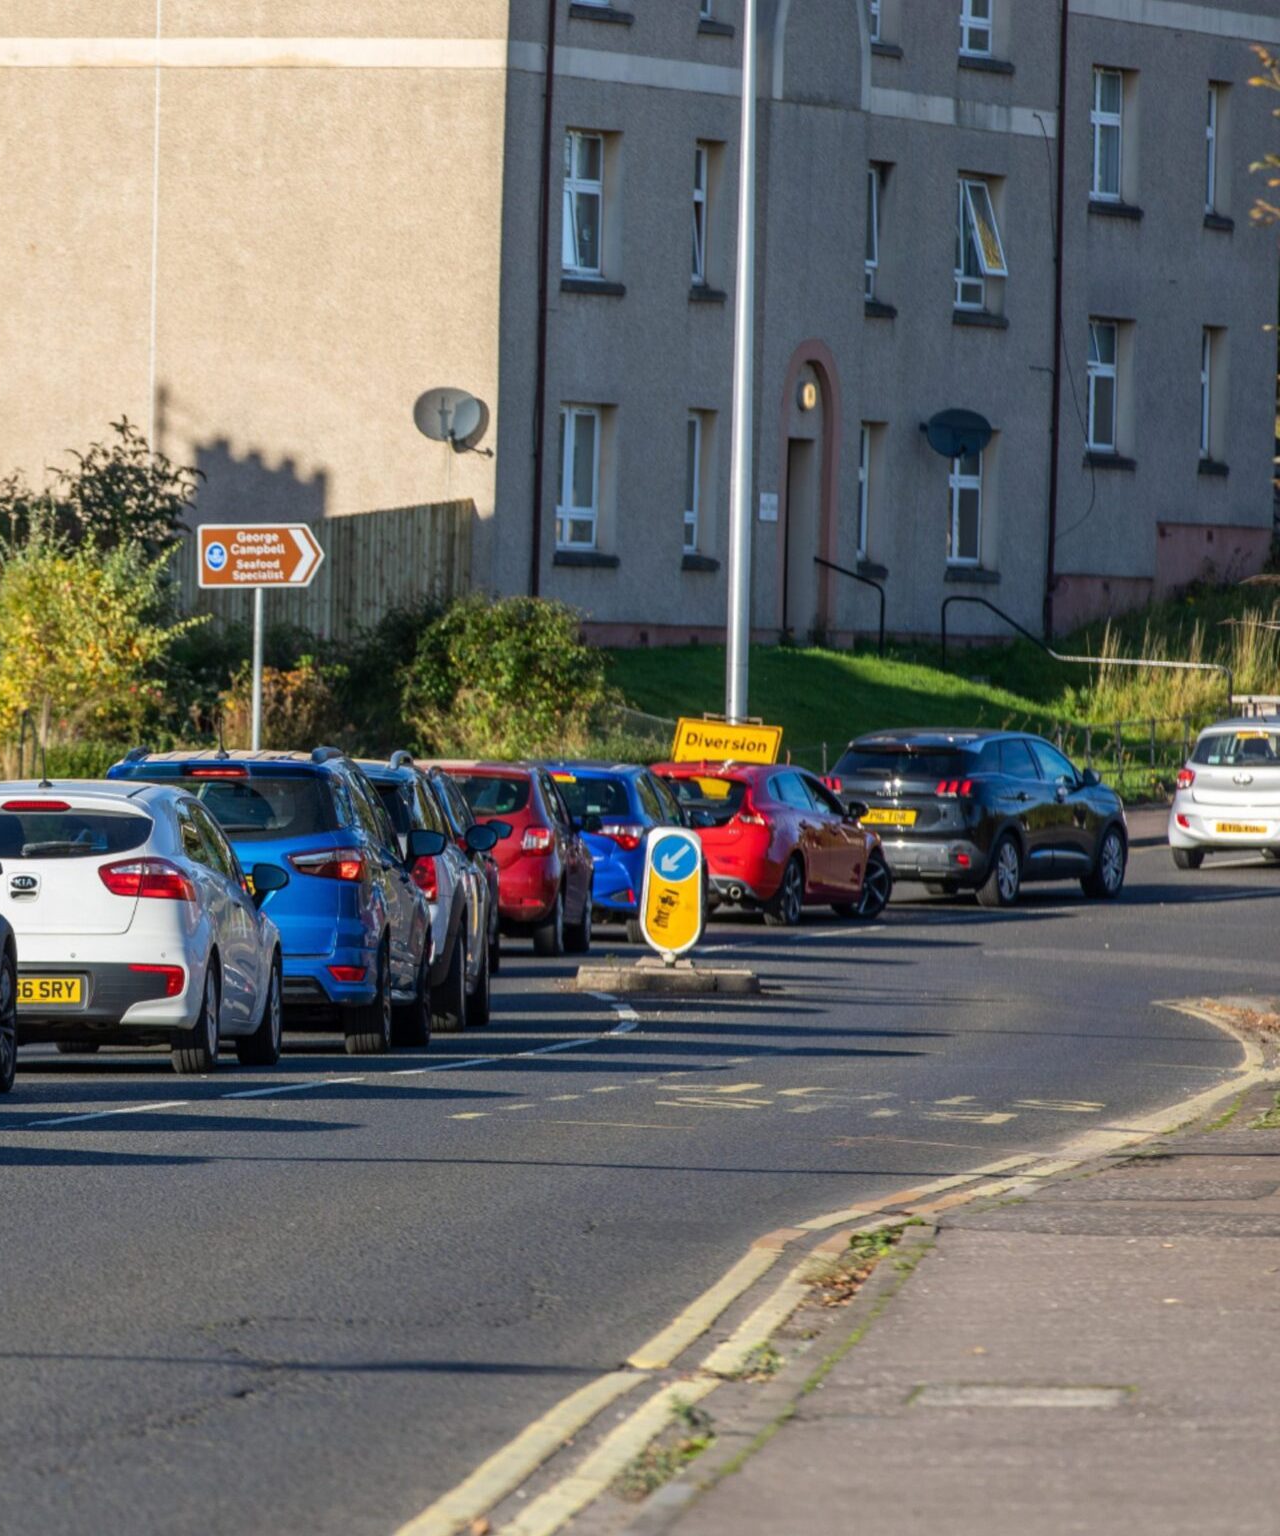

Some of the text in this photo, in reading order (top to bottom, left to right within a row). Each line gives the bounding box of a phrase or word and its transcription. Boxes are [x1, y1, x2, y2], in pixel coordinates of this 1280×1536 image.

[236, 531, 279, 544] George
[230, 543, 286, 556] Campbell
[236, 559, 280, 570] Seafood
[232, 570, 284, 581] Specialist
[685, 732, 768, 753] Diversion
[14, 878, 34, 887] KIA
[39, 981, 76, 998] SRY
